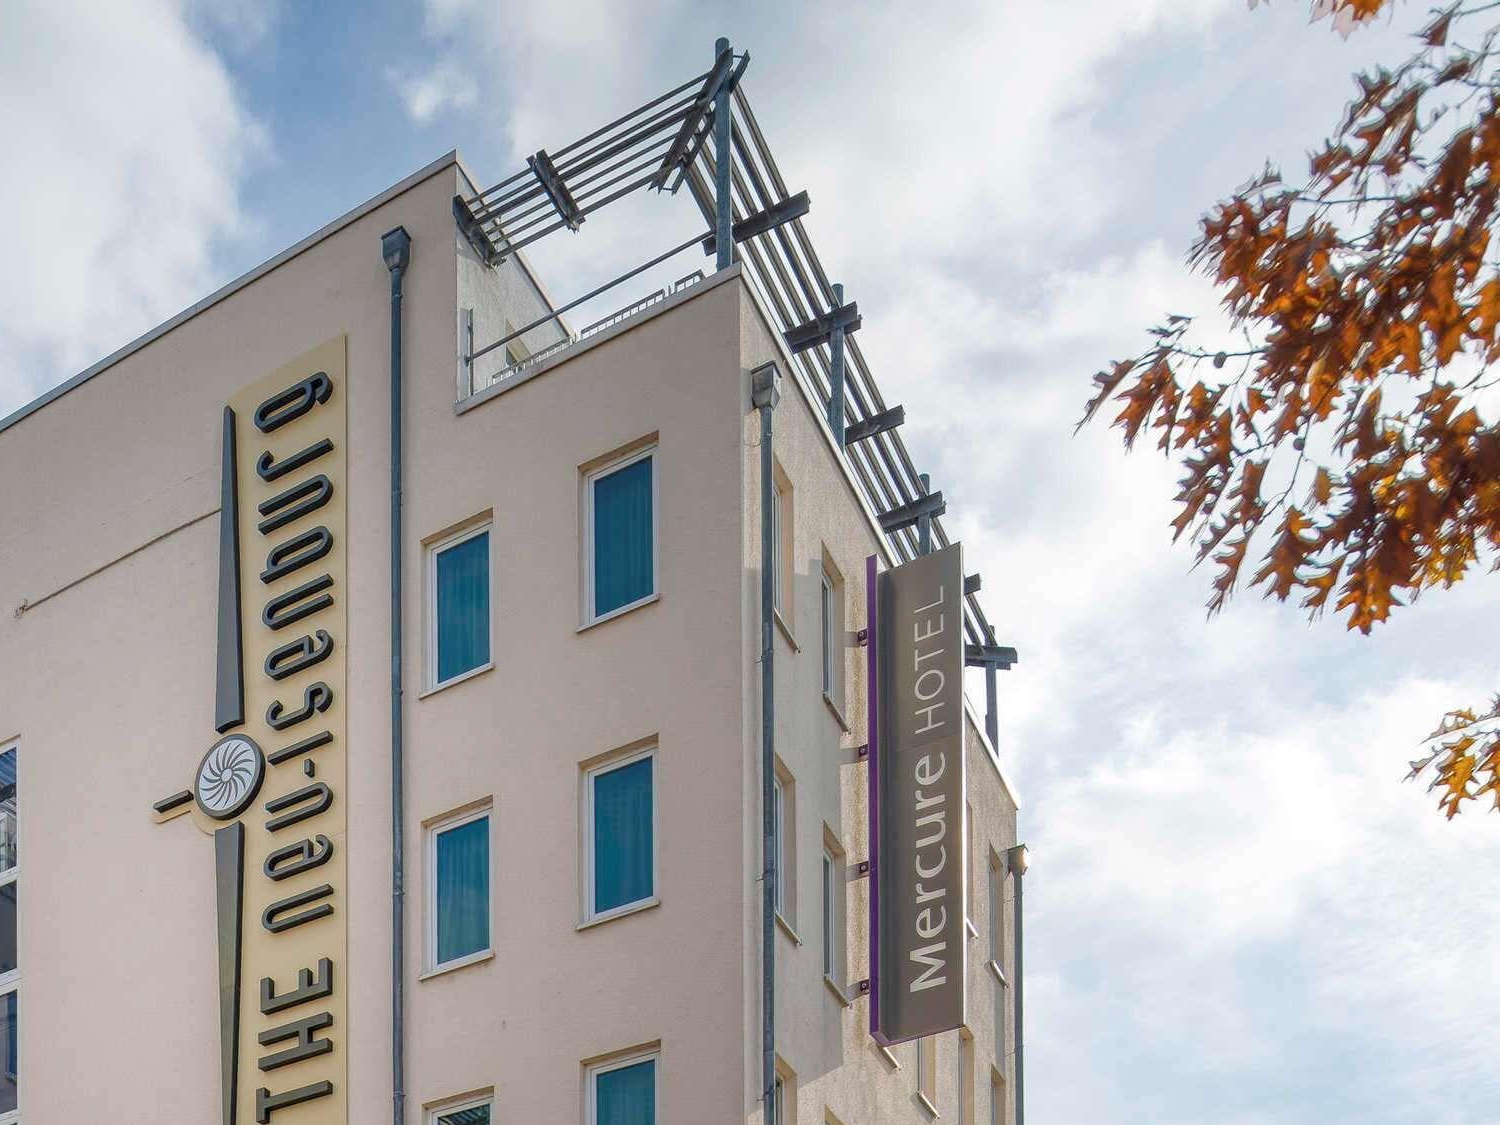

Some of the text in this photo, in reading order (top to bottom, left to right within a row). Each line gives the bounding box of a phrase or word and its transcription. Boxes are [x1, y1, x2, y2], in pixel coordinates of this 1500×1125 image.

[909, 584, 947, 993] Mercure HOTEL
[255, 957, 333, 1125] THE
